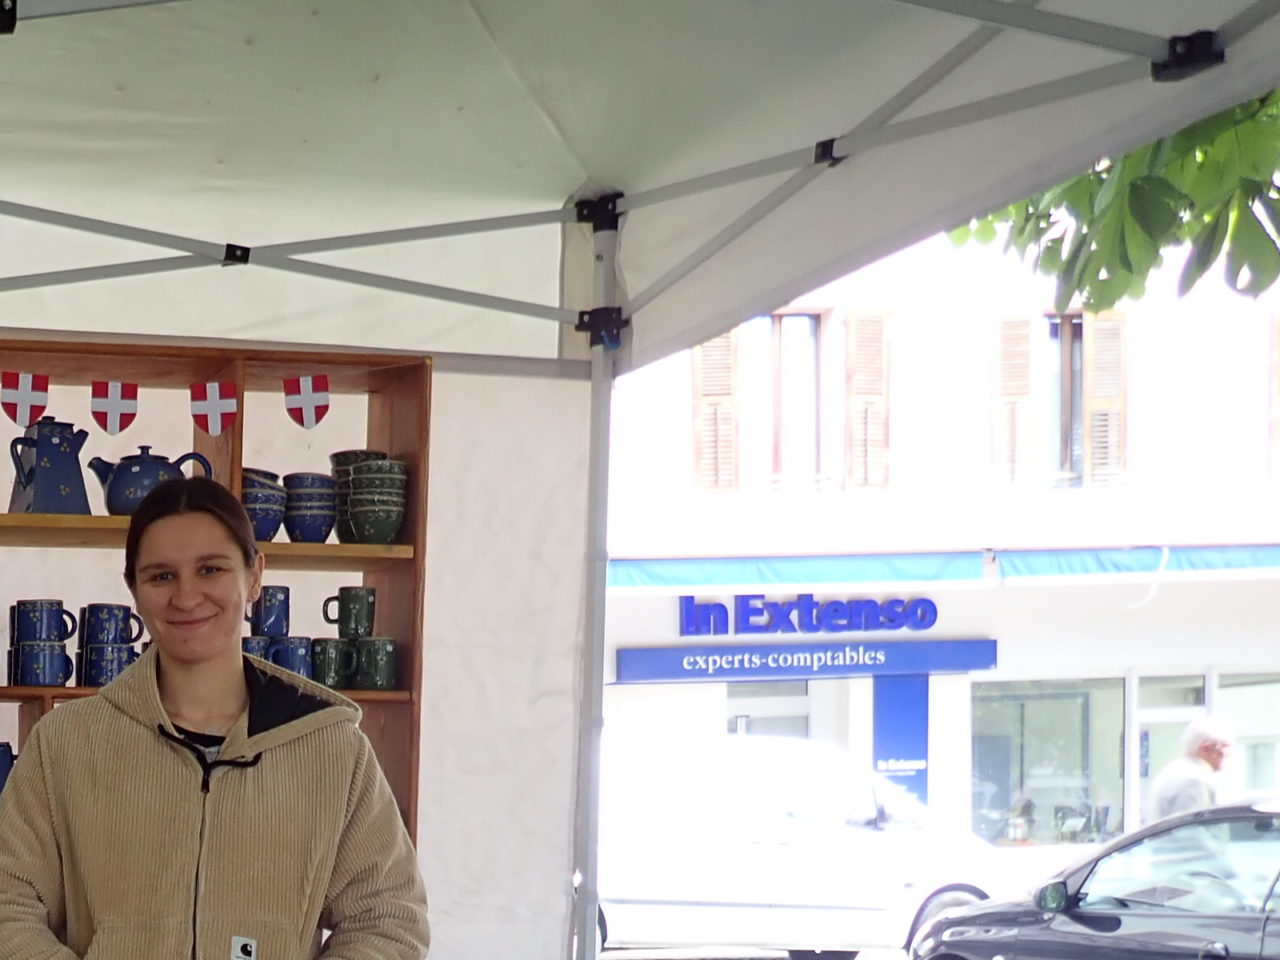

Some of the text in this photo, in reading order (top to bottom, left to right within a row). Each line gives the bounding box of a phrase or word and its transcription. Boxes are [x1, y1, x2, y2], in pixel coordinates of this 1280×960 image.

[678, 593, 938, 637] In Extenso
[682, 646, 886, 673] experts-comptables
